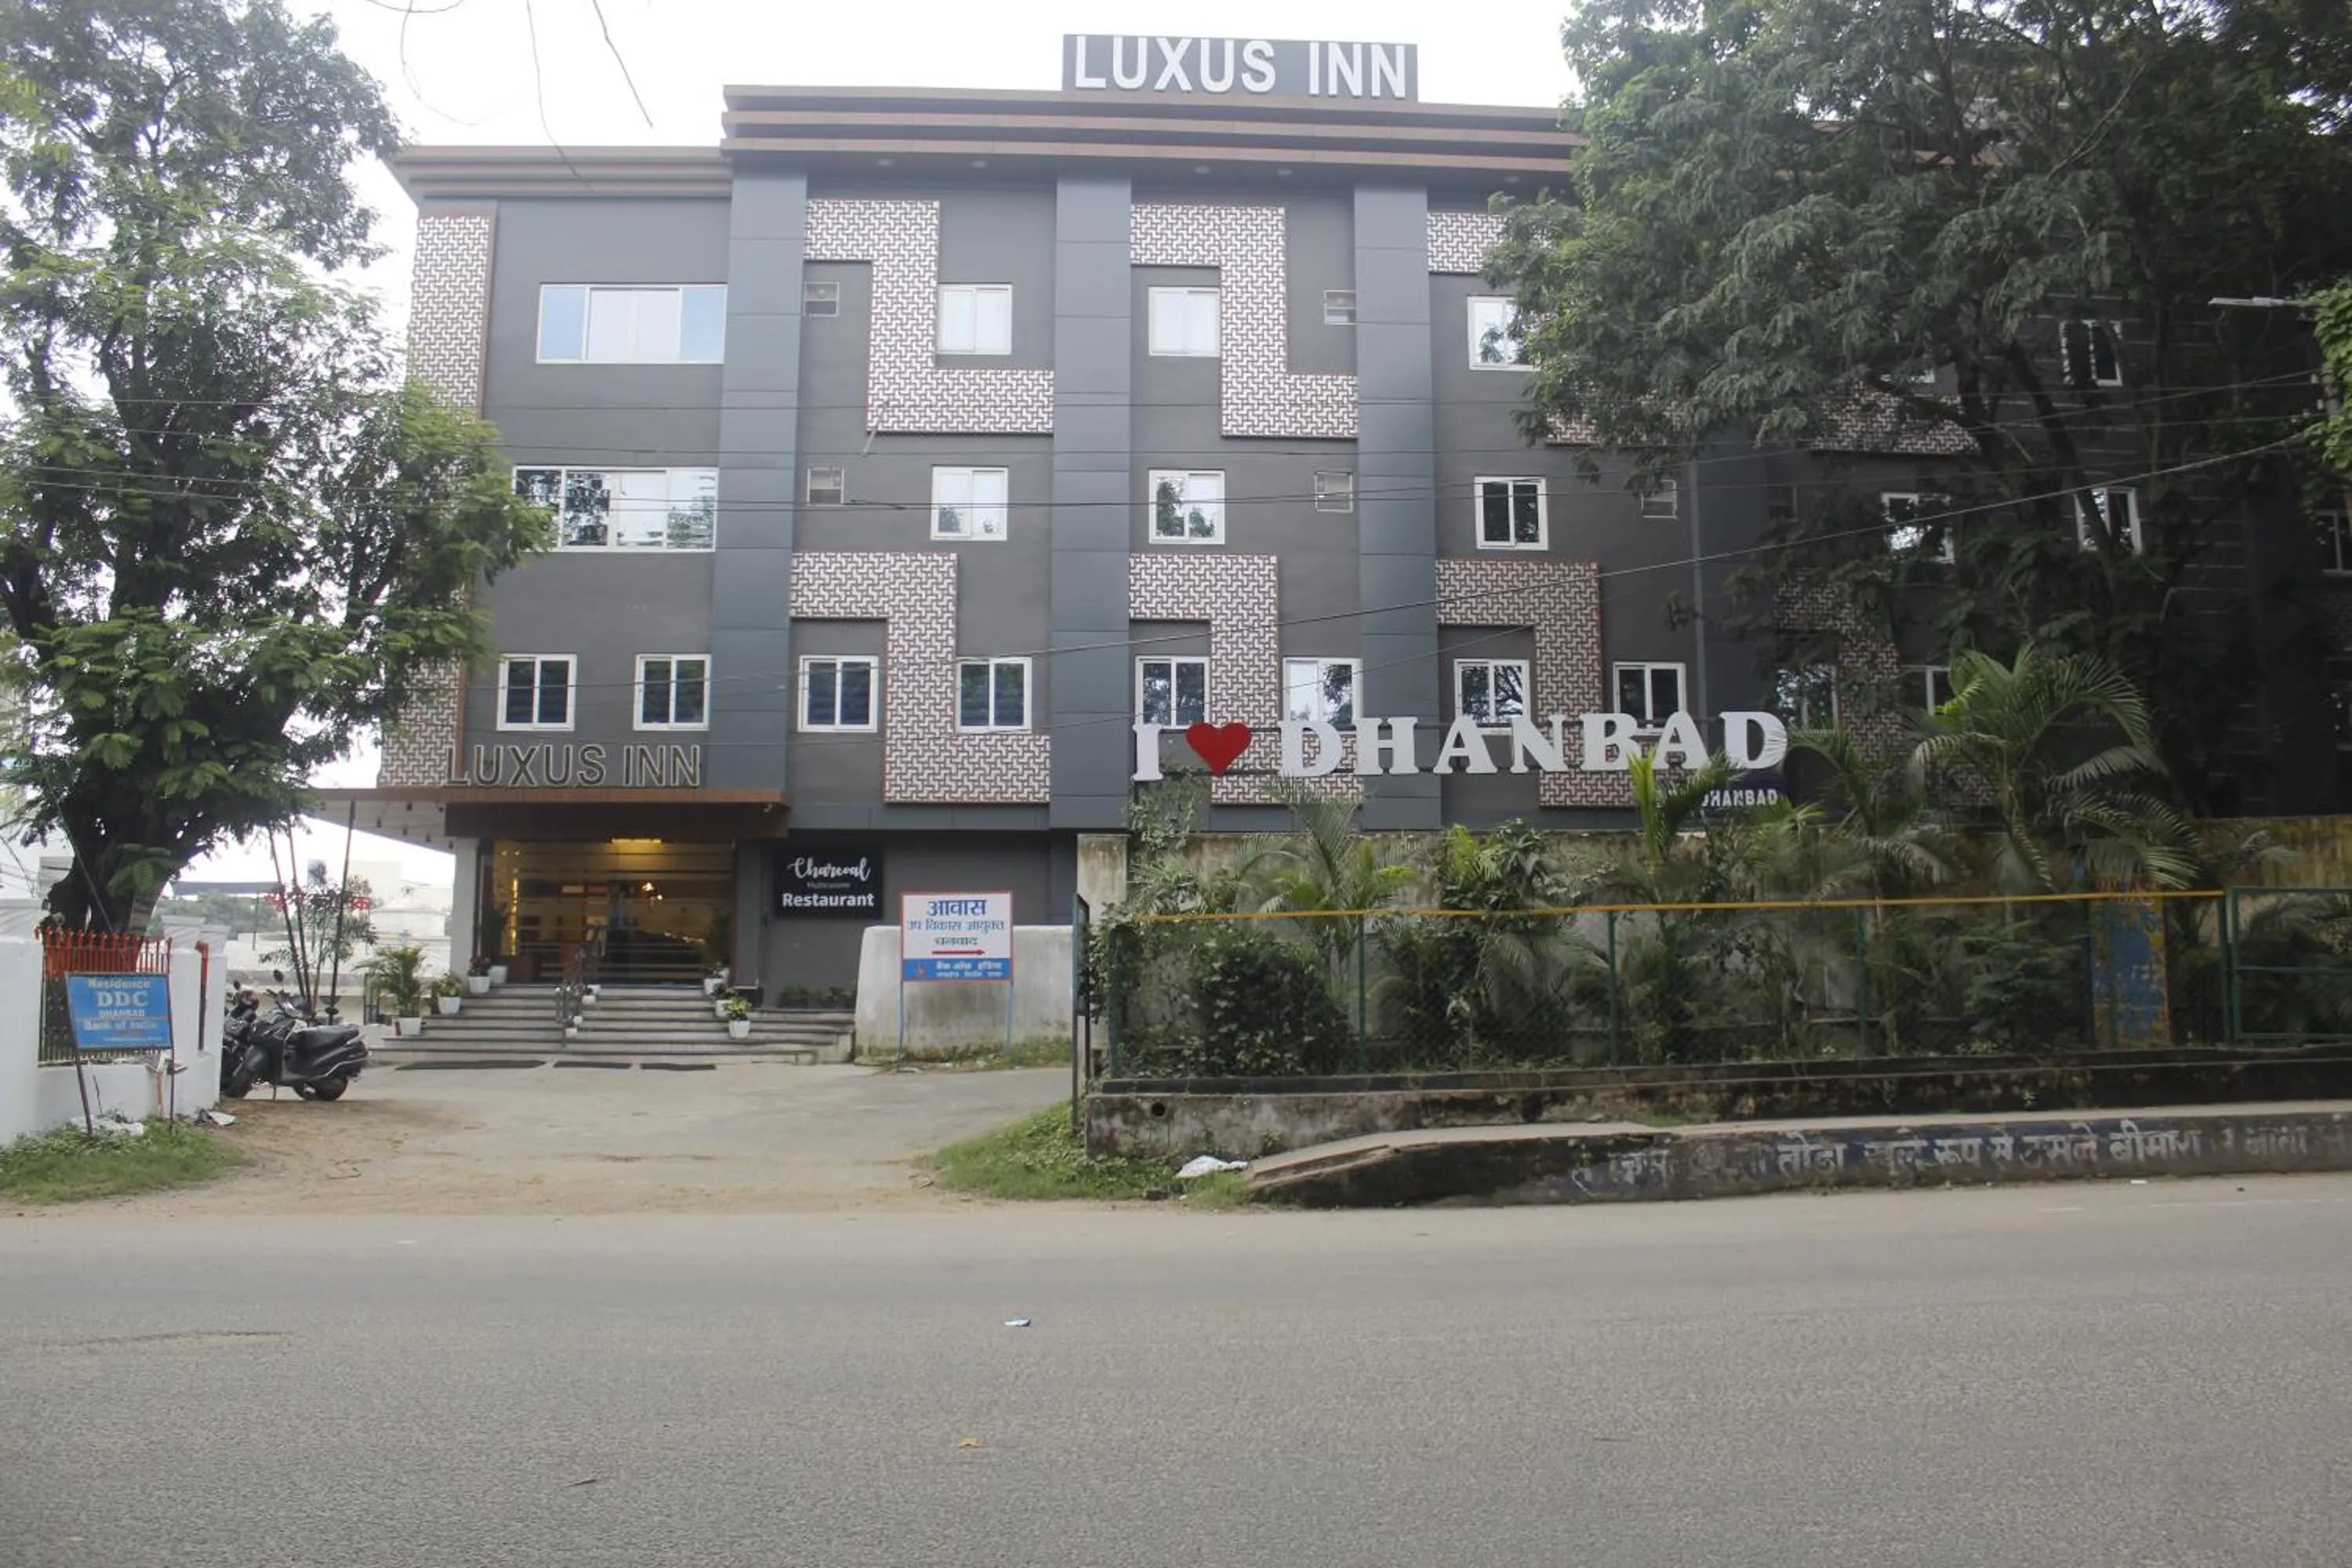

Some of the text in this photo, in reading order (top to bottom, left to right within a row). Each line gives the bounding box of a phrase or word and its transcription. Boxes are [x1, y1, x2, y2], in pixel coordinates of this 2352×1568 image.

[1075, 35, 1406, 98] LUXUS INN
[1131, 710, 1788, 782] I DHANBAD
[445, 744, 701, 787] LUXUS INN
[787, 856, 871, 882] Charcoal
[782, 892, 875, 907] Restaurant
[927, 899, 986, 916] आवास
[88, 978, 151, 989] Residence
[96, 990, 149, 1007] DDC
